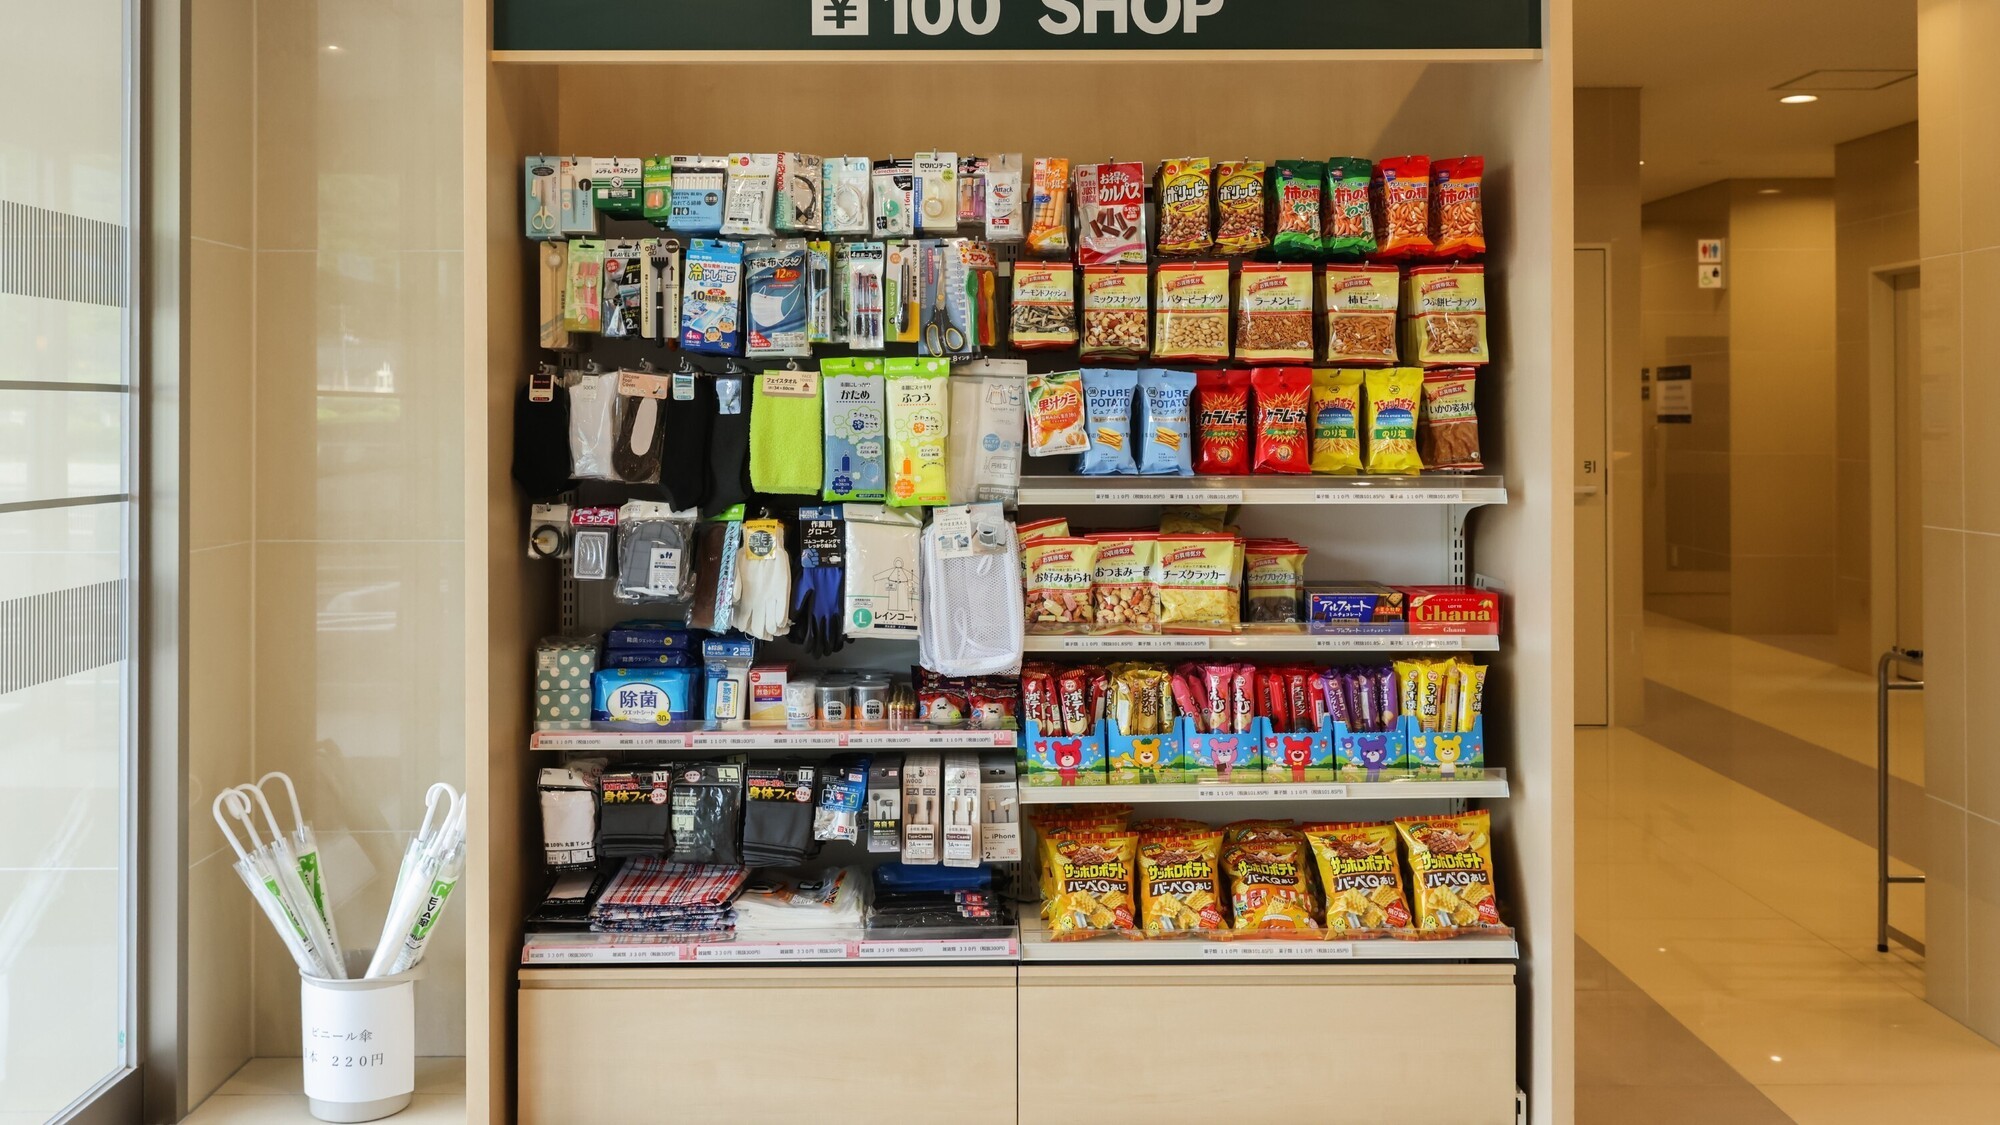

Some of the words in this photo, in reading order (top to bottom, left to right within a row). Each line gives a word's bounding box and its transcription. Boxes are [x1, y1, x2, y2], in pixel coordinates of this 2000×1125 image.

[884, 0, 1001, 36] 100
[1038, 0, 1224, 35] SHOP
[1100, 171, 1130, 184] お得な
[992, 185, 1014, 193] Attack
[1100, 182, 1141, 202] カルパス
[1388, 186, 1427, 205] 柿の種
[1439, 186, 1480, 206] 柿の種
[608, 249, 630, 258] TRAVEL
[748, 255, 803, 269] 不織布マスク
[1020, 288, 1067, 297] アーモンドフィッシュ
[1093, 295, 1141, 304] ミックスナッツ
[766, 377, 798, 385] フェイスタオル
[840, 389, 870, 400] かため
[902, 392, 931, 403] ふつう
[1100, 388, 1130, 398] PURE
[1159, 389, 1189, 399] PURE
[1038, 392, 1078, 412] 果汁グミ
[1091, 397, 1129, 408] POTATO
[1150, 398, 1188, 408] POTATO
[1314, 397, 1356, 411] スティックポテト
[1374, 397, 1416, 412] スティックポテト
[1201, 409, 1247, 425] カラムーチ
[1583, 460, 1597, 474] 引
[579, 514, 613, 523] トランプ
[811, 520, 833, 528] 作業用
[807, 527, 838, 536] グローブ
[1034, 571, 1091, 583] お好みあられ
[1095, 566, 1151, 577] おつまみ一番
[1163, 570, 1226, 580] チーズクラッカー
[1320, 599, 1372, 612] アルフォート
[1416, 602, 1491, 622] Ghana
[858, 616, 867, 624] L
[620, 690, 658, 709] 除菌
[1029, 689, 1041, 719] ポテト
[1071, 688, 1085, 721] ポテト
[1209, 687, 1226, 714] えび
[1234, 688, 1251, 714] えび
[1294, 686, 1307, 716] チョコチップ
[1423, 682, 1437, 716] うす焼
[622, 709, 655, 717] ウエットシート
[654, 772, 665, 781] M
[725, 769, 732, 778] L
[800, 771, 812, 780] LL
[873, 821, 895, 829] 高音質
[1432, 821, 1458, 829] Calbee
[1341, 832, 1367, 843] Calbee
[1165, 841, 1191, 849] Calbee
[1247, 874, 1294, 885] バーベQあじ
[1337, 875, 1395, 891] バーベQあじ
[1428, 872, 1486, 888] バーベQあじ
[1068, 880, 1127, 894] バーベQあじ
[1152, 880, 1212, 895] バーベQあじ
[311, 1028, 373, 1042] ビニール傘
[331, 1051, 384, 1068] 220円
